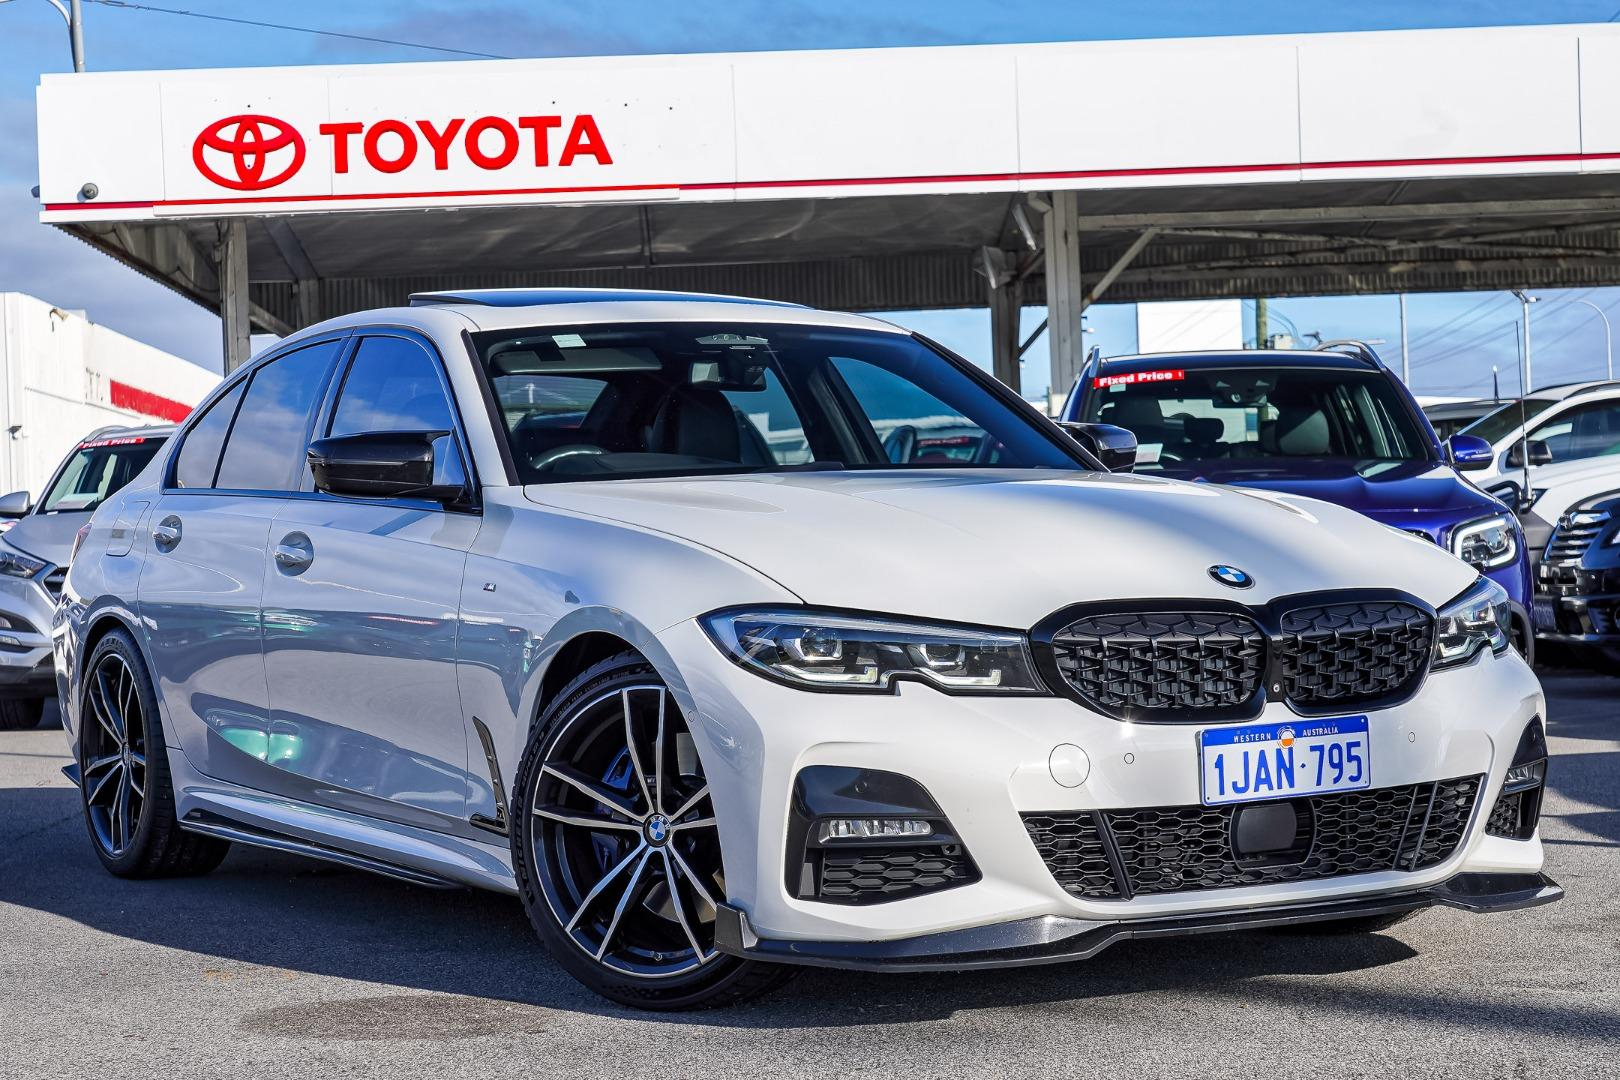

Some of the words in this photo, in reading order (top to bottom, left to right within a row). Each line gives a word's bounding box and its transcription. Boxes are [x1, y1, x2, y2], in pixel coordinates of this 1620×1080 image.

[319, 114, 613, 173] TOYOTA
[1099, 374, 1135, 387] Fixed
[1138, 371, 1172, 381] Price
[1233, 733, 1271, 743] WESTERN
[1302, 726, 1339, 737] AUSTRALIA
